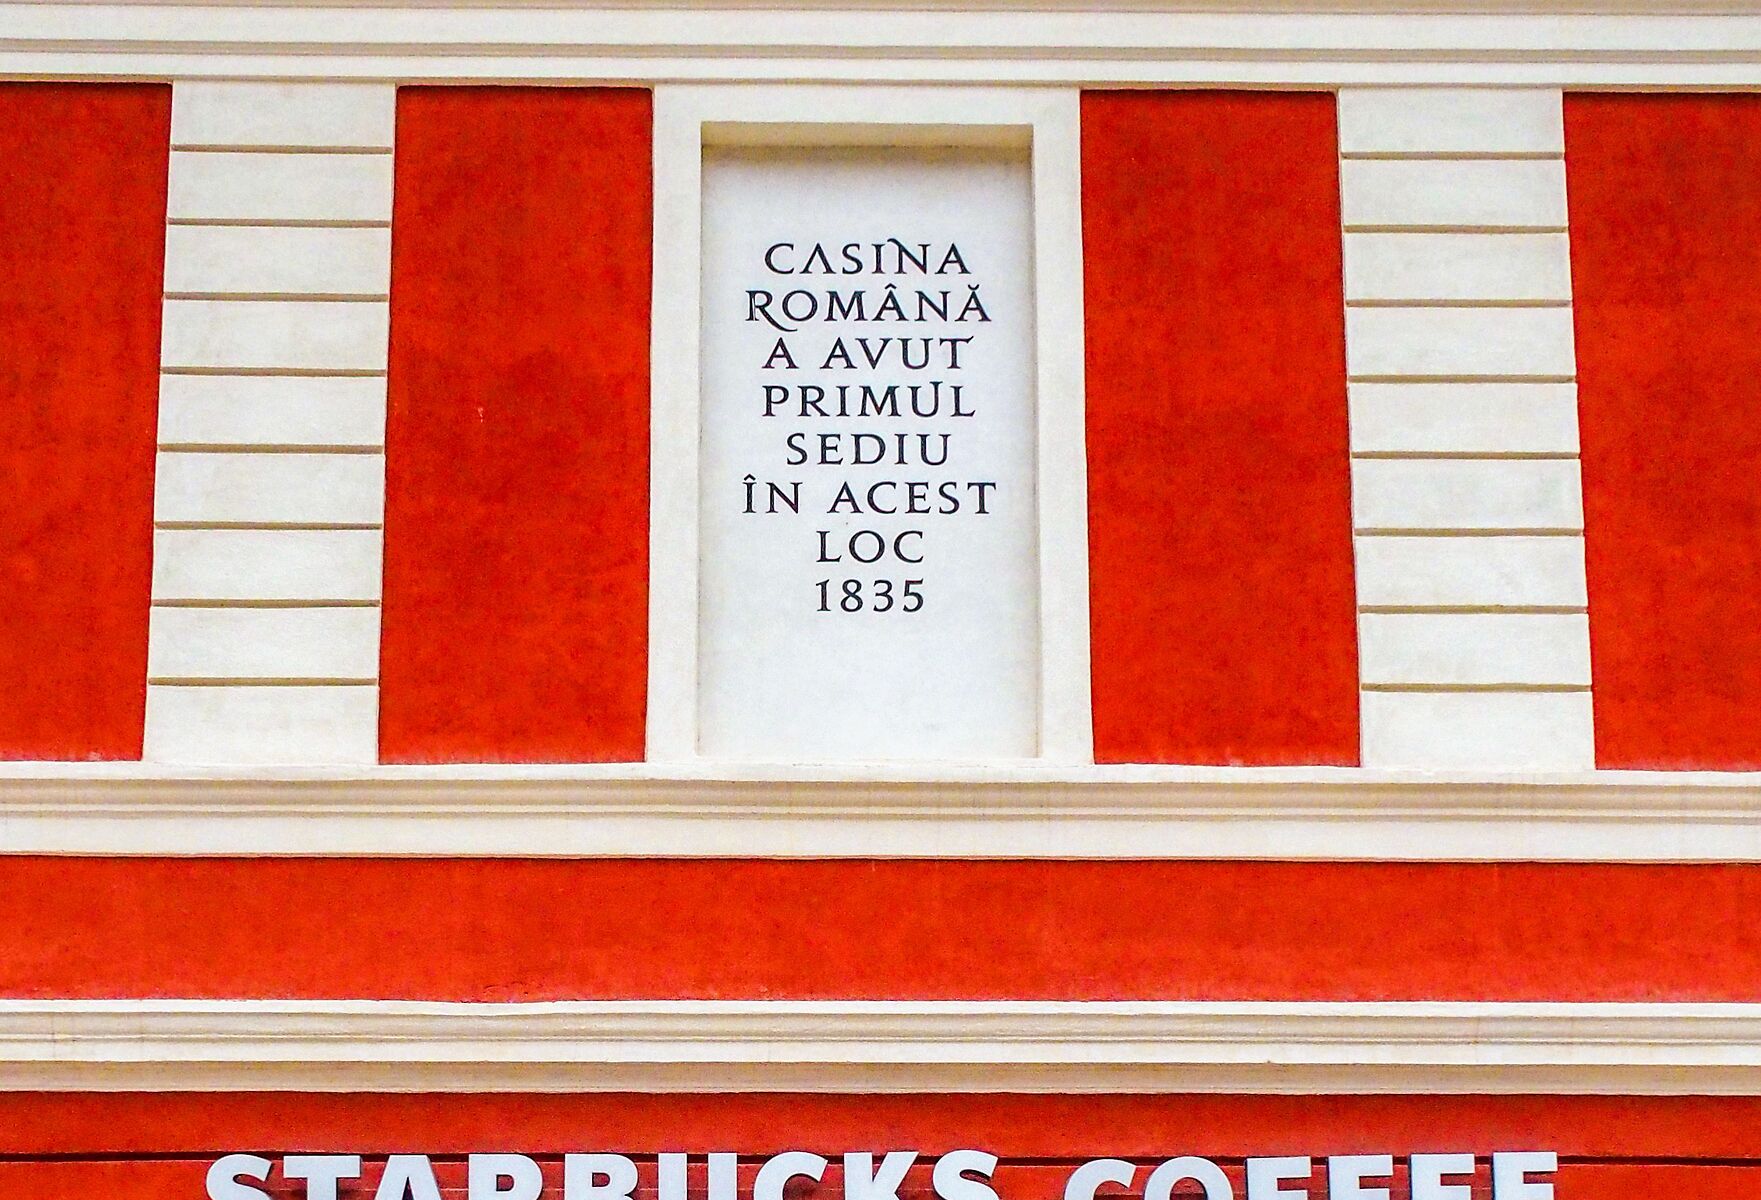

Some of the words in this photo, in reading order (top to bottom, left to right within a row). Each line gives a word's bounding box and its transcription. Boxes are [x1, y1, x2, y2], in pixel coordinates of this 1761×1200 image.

[764, 237, 971, 275] CASINA
[745, 282, 992, 332] ROMÂNĂ
[761, 336, 799, 370] A
[819, 335, 974, 371] AVUT
[761, 381, 976, 418] PRIMUL
[785, 432, 951, 466] SEDIU
[742, 473, 803, 515] ÎN
[826, 481, 997, 515] ACEST
[816, 530, 924, 564] LOC
[815, 578, 924, 613] 1835
